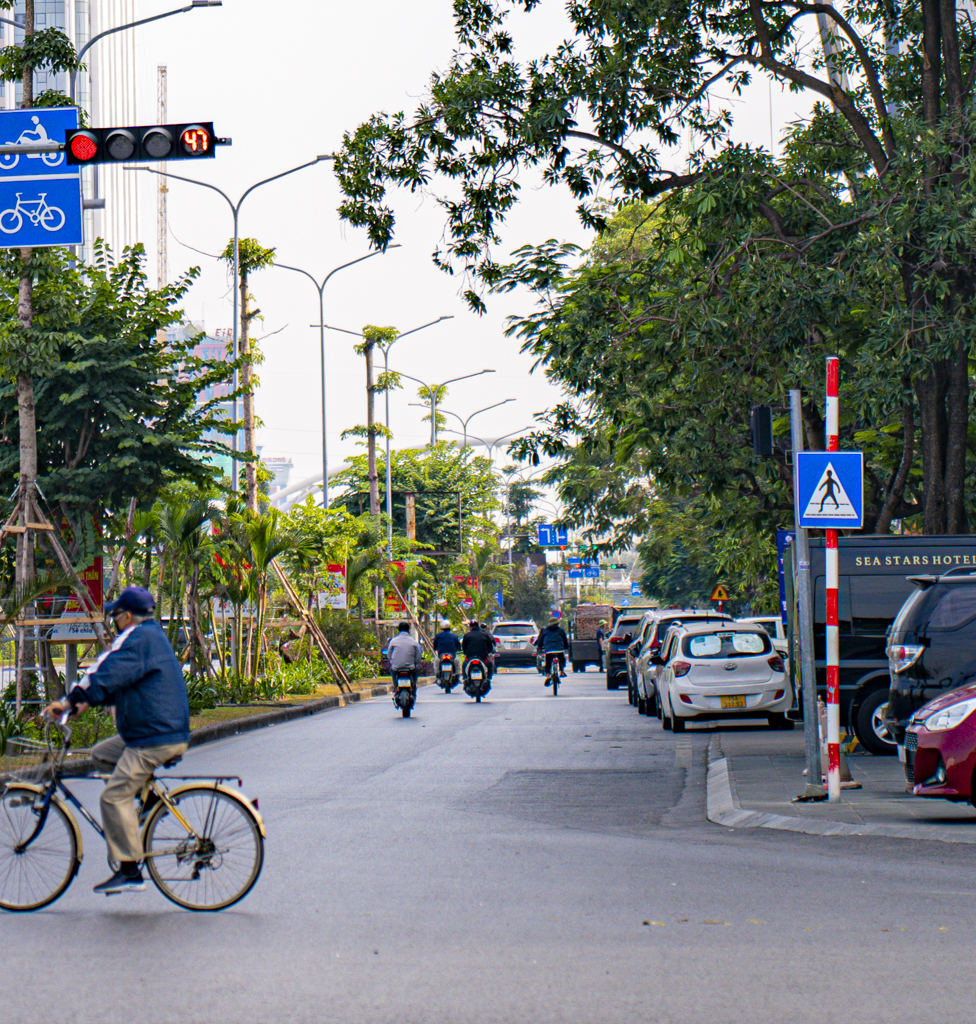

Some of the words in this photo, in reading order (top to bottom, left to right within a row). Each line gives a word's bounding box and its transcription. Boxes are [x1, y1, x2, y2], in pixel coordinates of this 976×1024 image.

[184, 129, 208, 151] 47
[855, 556, 881, 566] SEA
[885, 555, 929, 565] STARS
[933, 555, 976, 565] HOTEL
